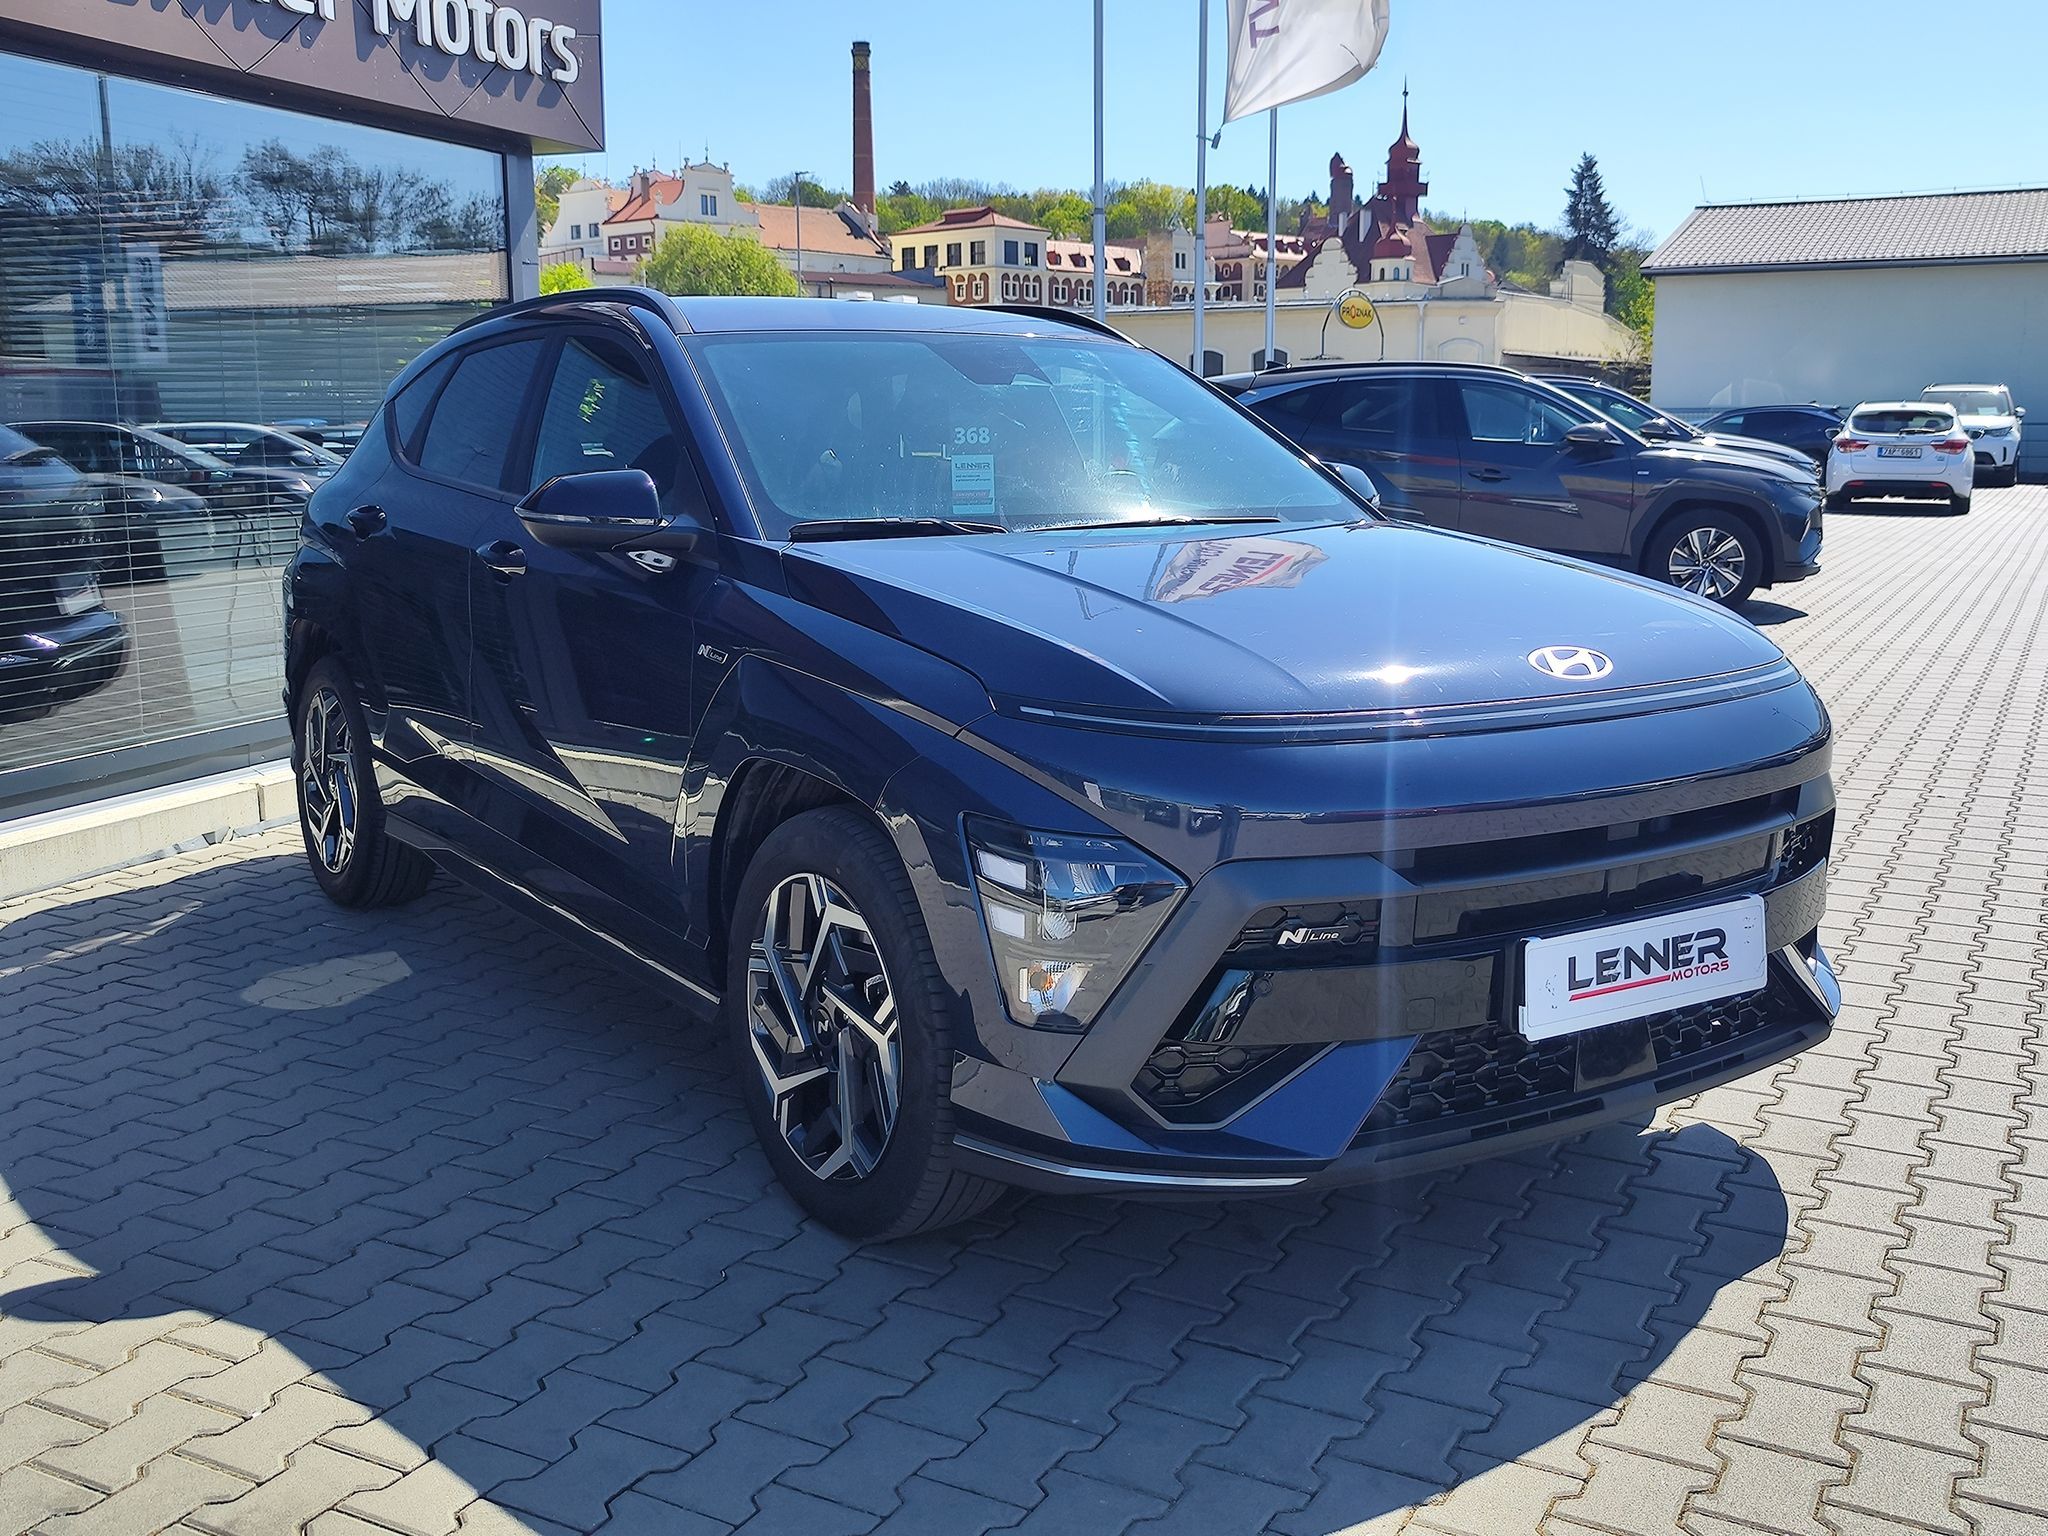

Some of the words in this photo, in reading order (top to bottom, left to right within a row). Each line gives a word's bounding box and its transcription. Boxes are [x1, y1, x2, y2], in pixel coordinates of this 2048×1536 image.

[373, 0, 578, 84] Motors
[954, 426, 991, 445] 368
[1310, 932, 1340, 941] Line
[1567, 927, 1729, 992] LENNER
[1670, 959, 1730, 983] MOTORS
